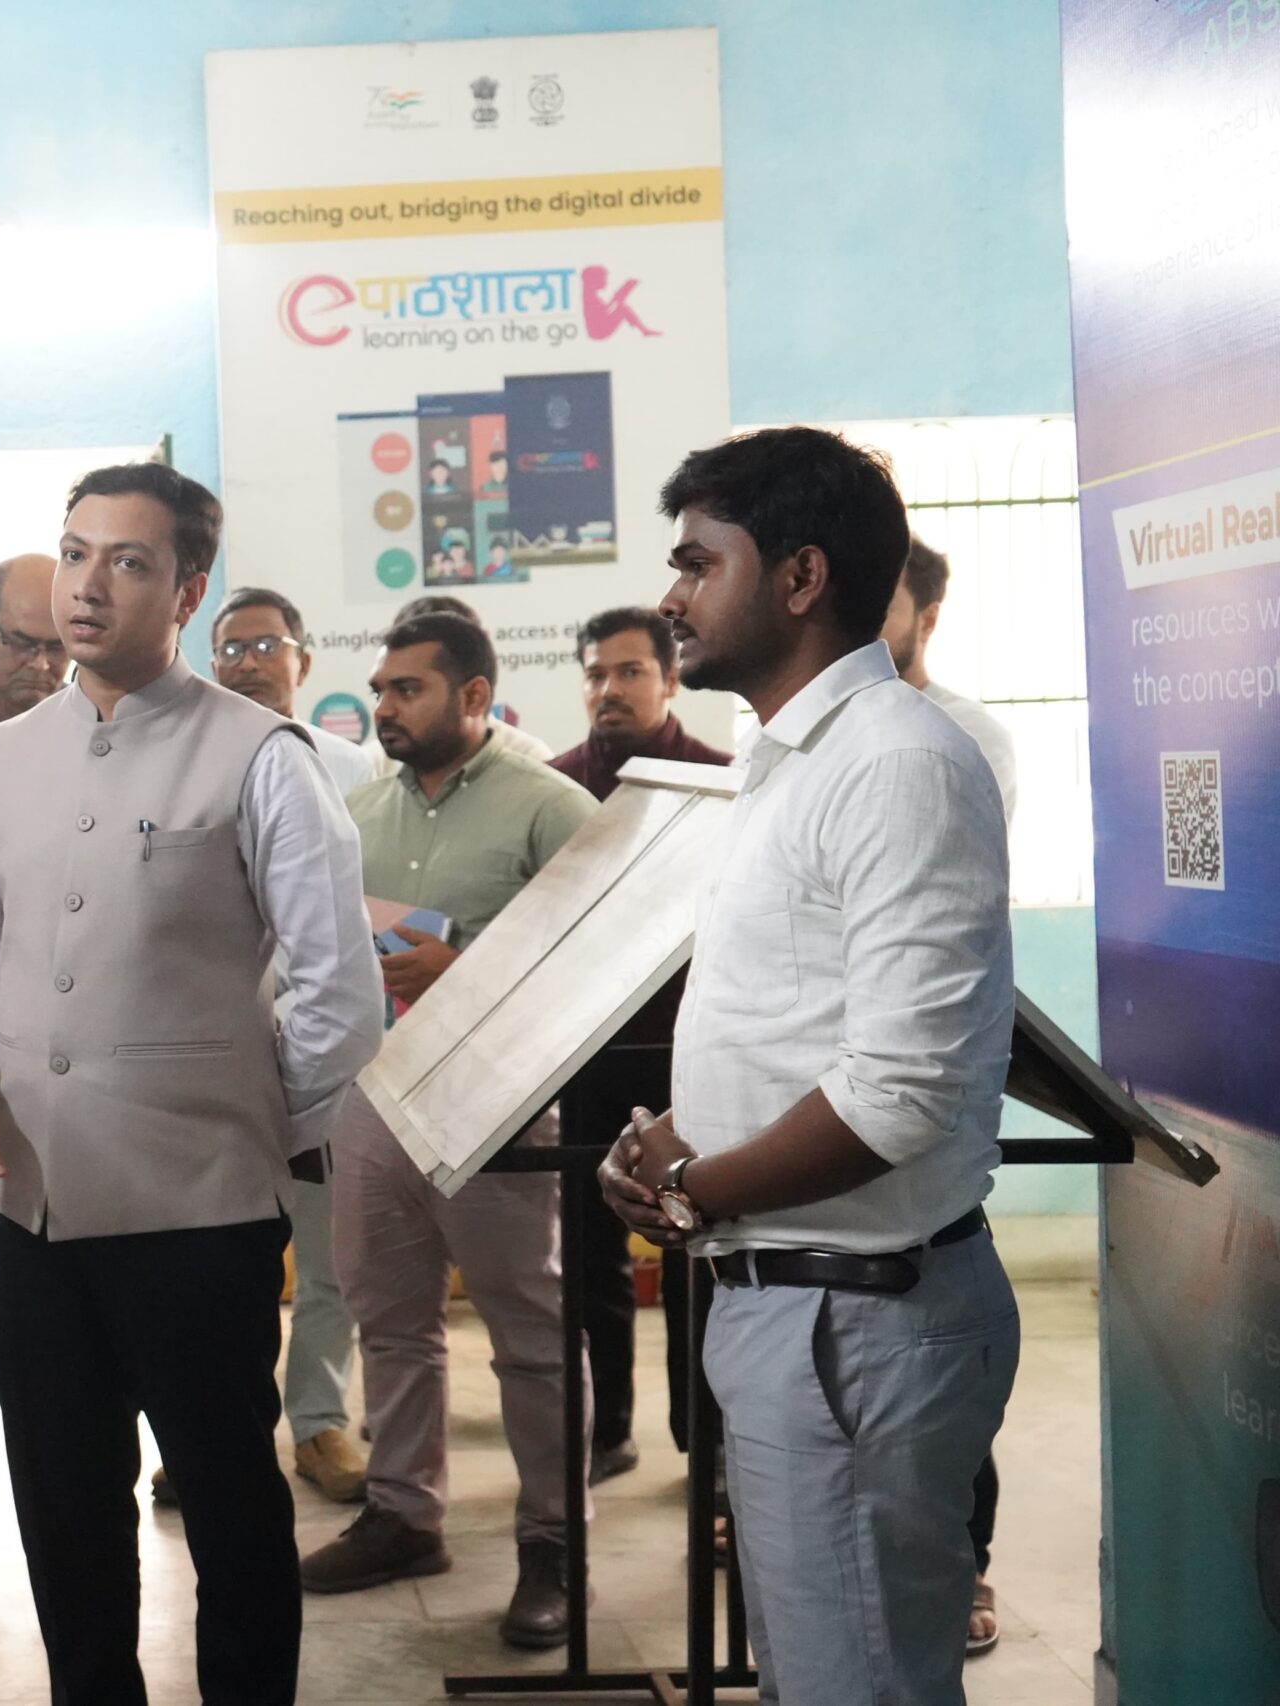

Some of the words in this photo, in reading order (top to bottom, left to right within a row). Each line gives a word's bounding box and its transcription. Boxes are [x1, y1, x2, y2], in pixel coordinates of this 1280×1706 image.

[233, 200, 342, 228] Reaching
[350, 201, 393, 224] out,
[400, 190, 499, 221] bridging
[505, 191, 543, 214] the
[548, 188, 623, 217] digital
[630, 184, 702, 208] divide
[362, 322, 458, 352] learning
[464, 325, 495, 346] on
[501, 317, 540, 343] the
[546, 321, 578, 346] go
[1129, 507, 1213, 566] Virtual
[496, 623, 558, 641] access
[1132, 601, 1250, 647] resources
[1133, 665, 1172, 708] the
